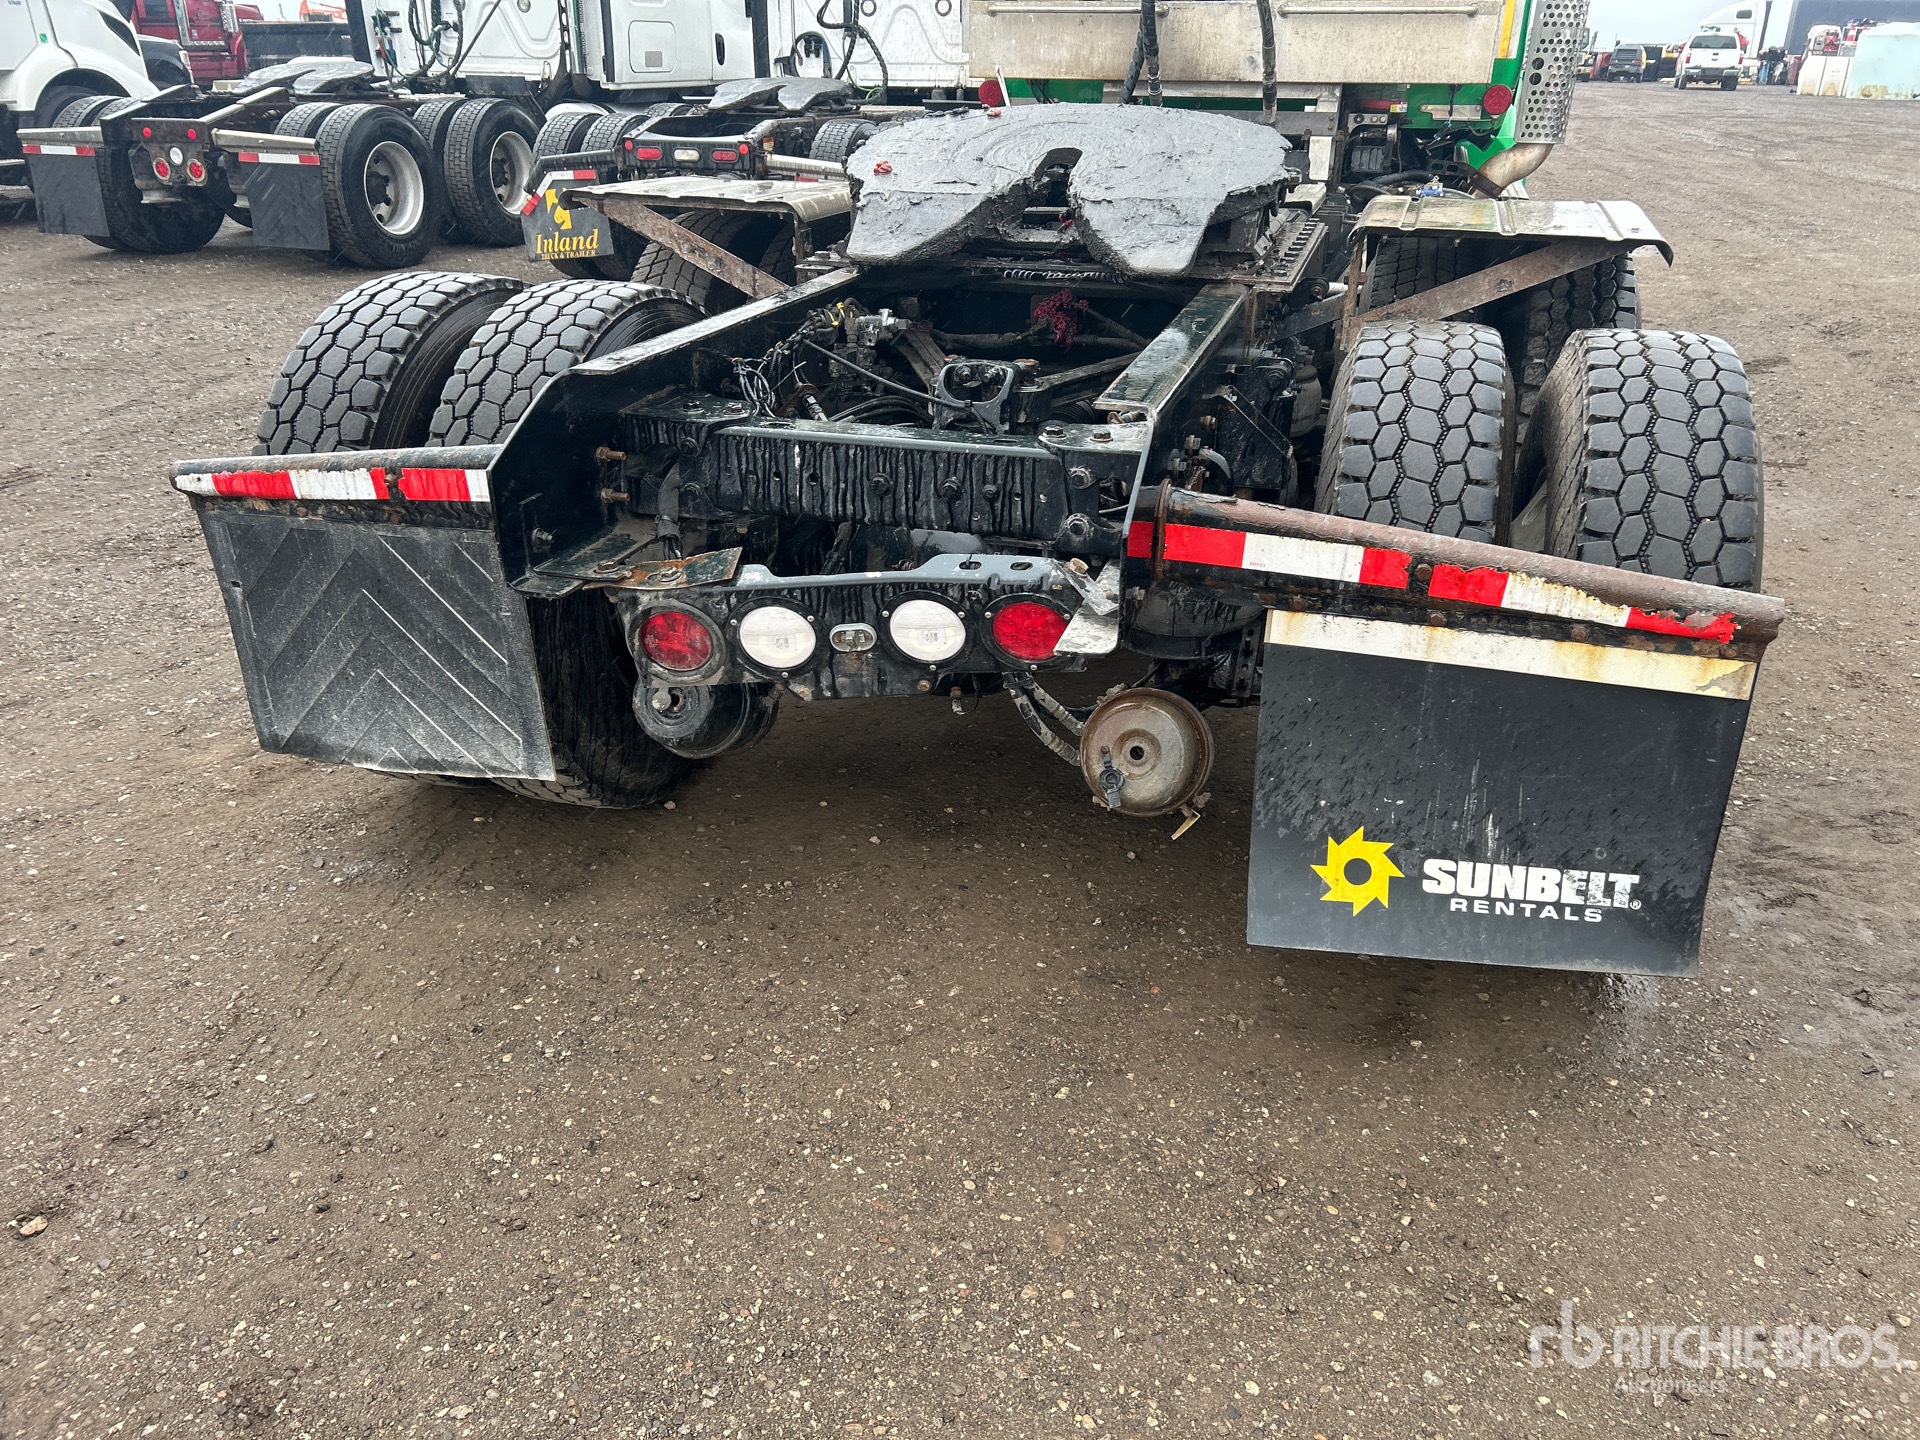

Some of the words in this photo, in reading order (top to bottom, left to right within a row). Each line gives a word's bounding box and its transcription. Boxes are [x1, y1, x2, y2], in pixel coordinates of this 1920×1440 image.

[536, 229, 599, 254] Inland
[566, 249, 596, 258] TRAILER
[1422, 858, 1641, 909] SUNBELT
[1449, 898, 1603, 924] RENTALS
